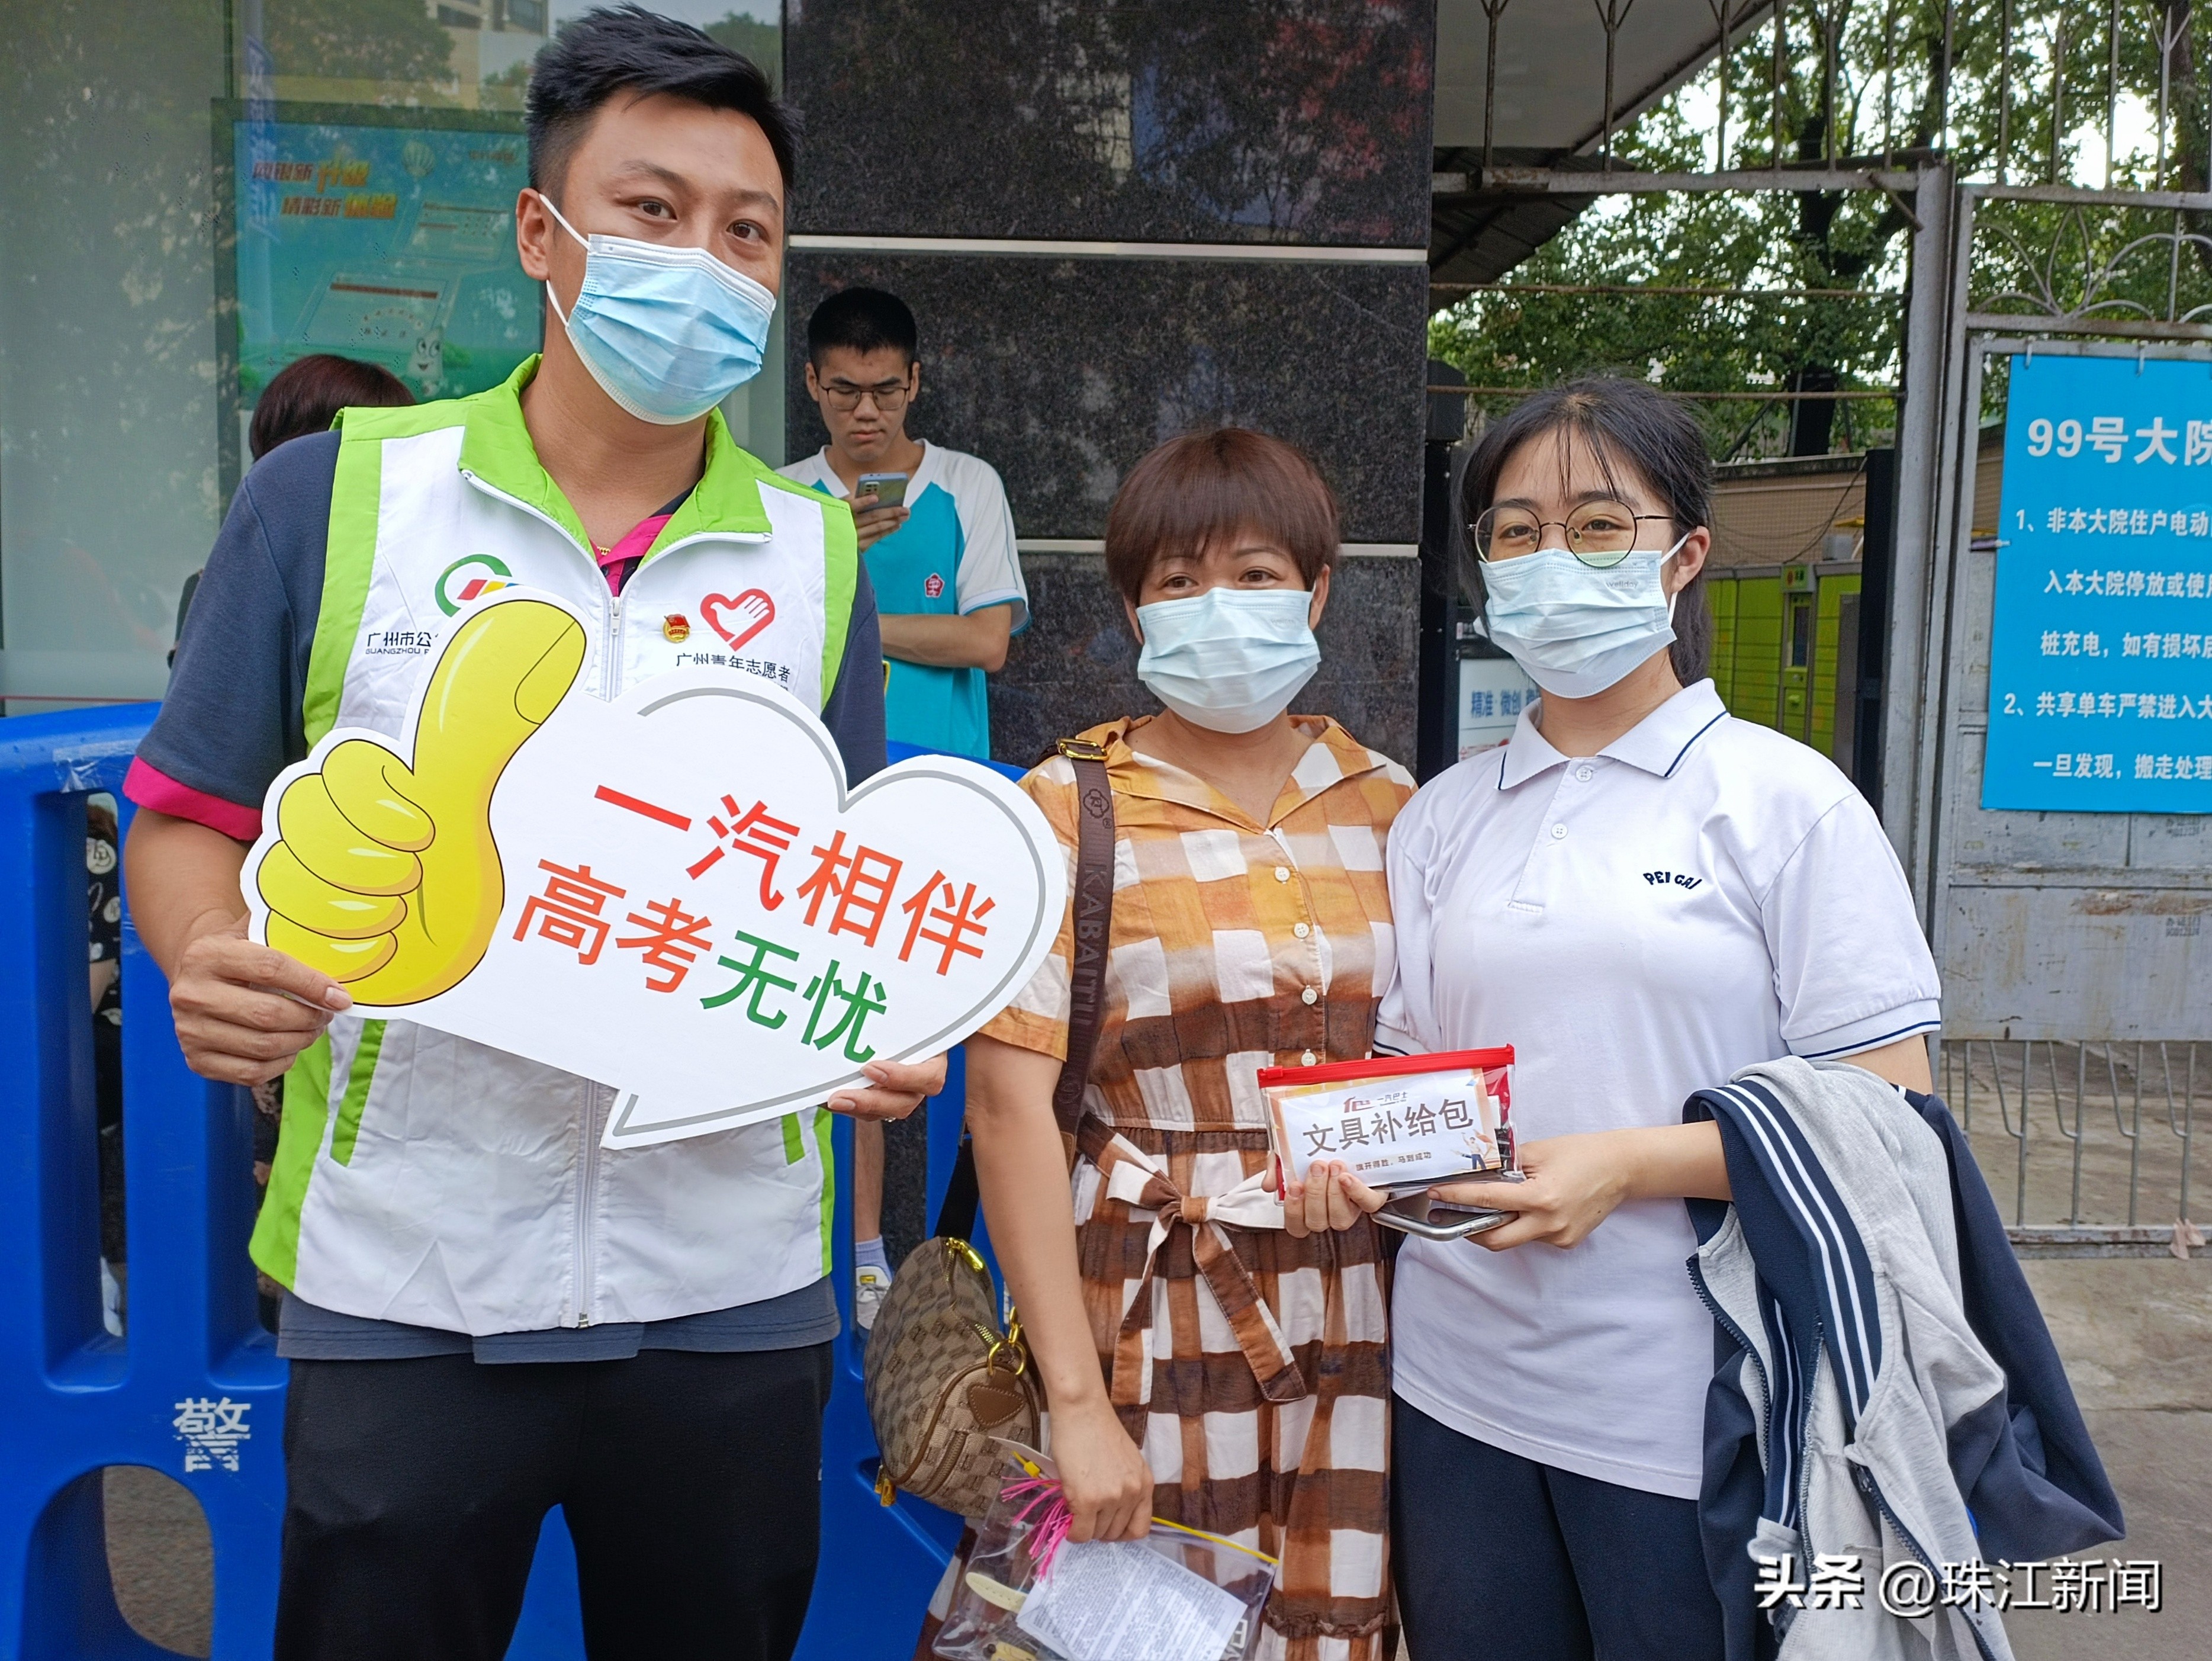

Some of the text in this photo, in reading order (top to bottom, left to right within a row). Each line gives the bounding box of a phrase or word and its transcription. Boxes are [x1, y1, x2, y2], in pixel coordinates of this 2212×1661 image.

[2027, 416, 2212, 465] 99号大院
[2016, 507, 2212, 536] 1、非本大院住户电动
[366, 631, 439, 647] 广州市公
[676, 653, 790, 683] 广州青年志愿者
[594, 785, 996, 976] 一汽相伴
[1642, 870, 1671, 885] PEI
[513, 859, 887, 1063] 高考无忧
[1303, 1098, 1474, 1157] 文具补给包
[172, 1396, 252, 1473] 警
